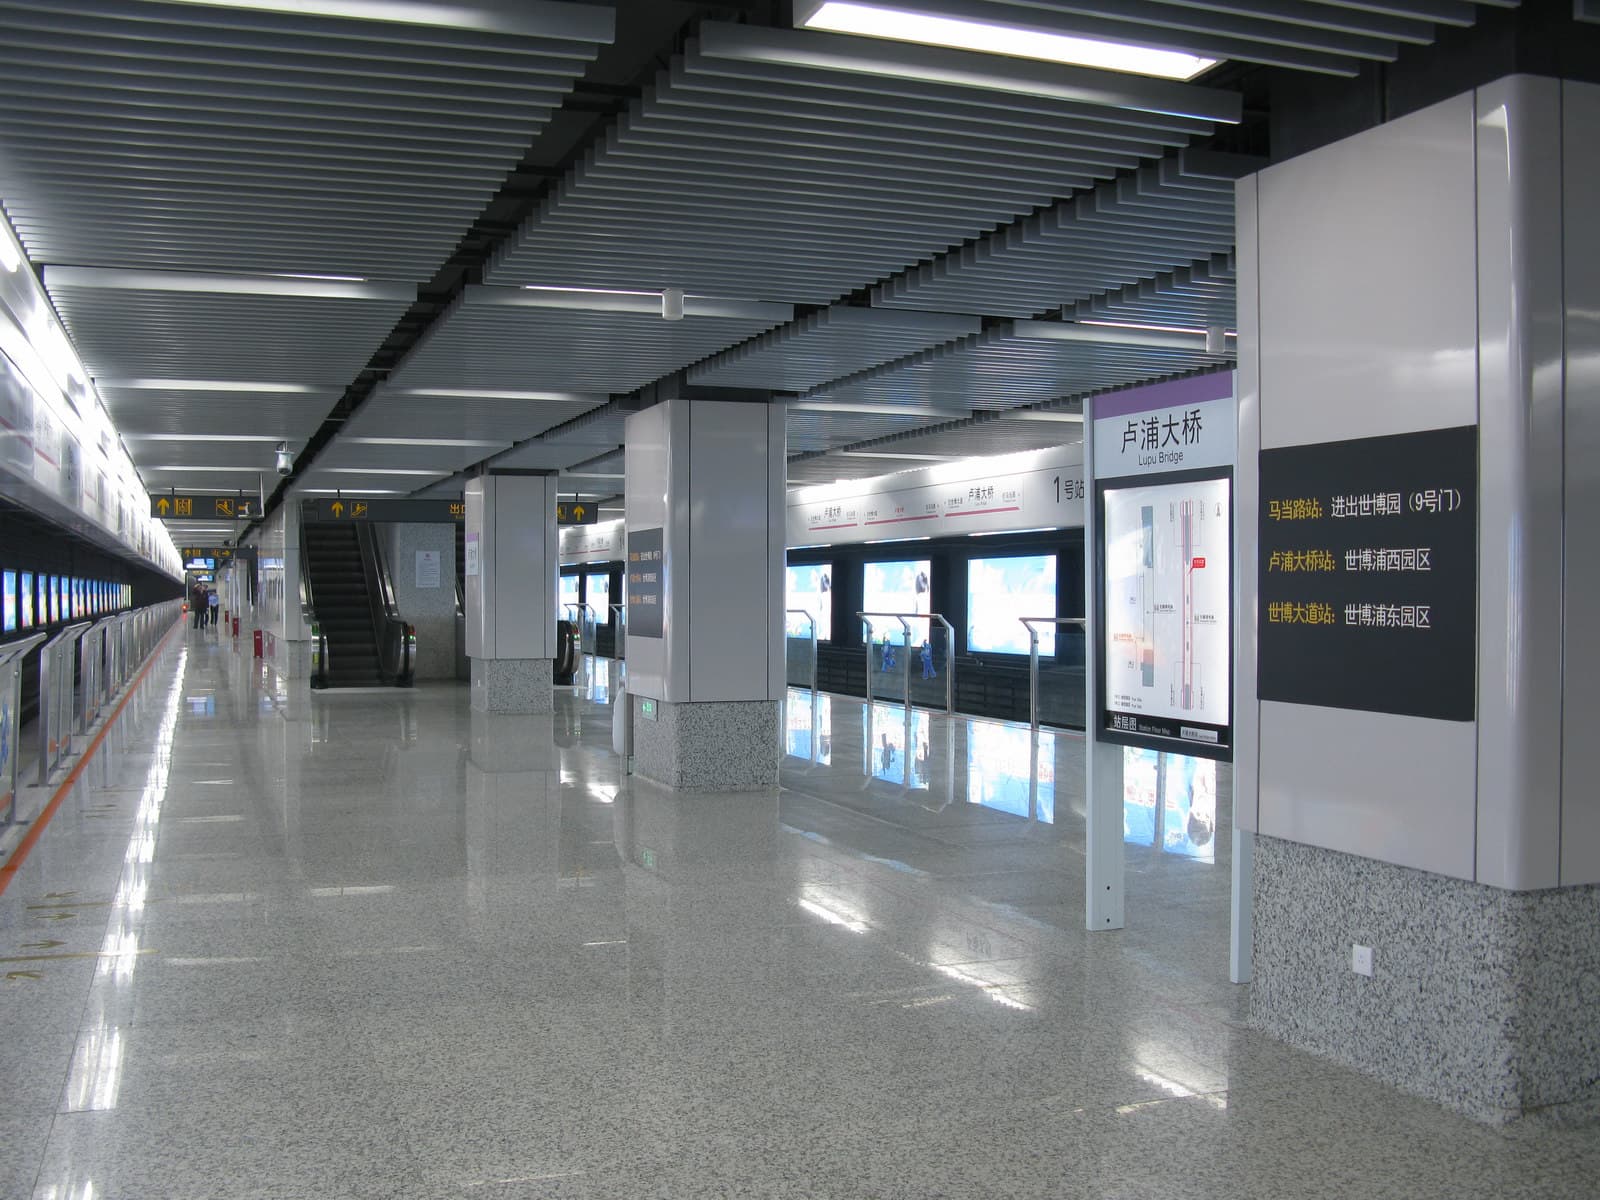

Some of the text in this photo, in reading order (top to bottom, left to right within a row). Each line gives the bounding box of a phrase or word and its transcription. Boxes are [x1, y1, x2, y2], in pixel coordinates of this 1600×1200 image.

[1121, 408, 1203, 454] 卢浦大桥
[1138, 450, 1184, 468] Lupu Bridge
[1268, 488, 1462, 521] 马当路站： 进出世博园（9号门）
[1268, 547, 1432, 572] 卢浦大桥站： 世博浦西园区
[1268, 601, 1431, 628] 世博大道站： 世博浦东园区
[1113, 715, 1137, 731] 站层图
